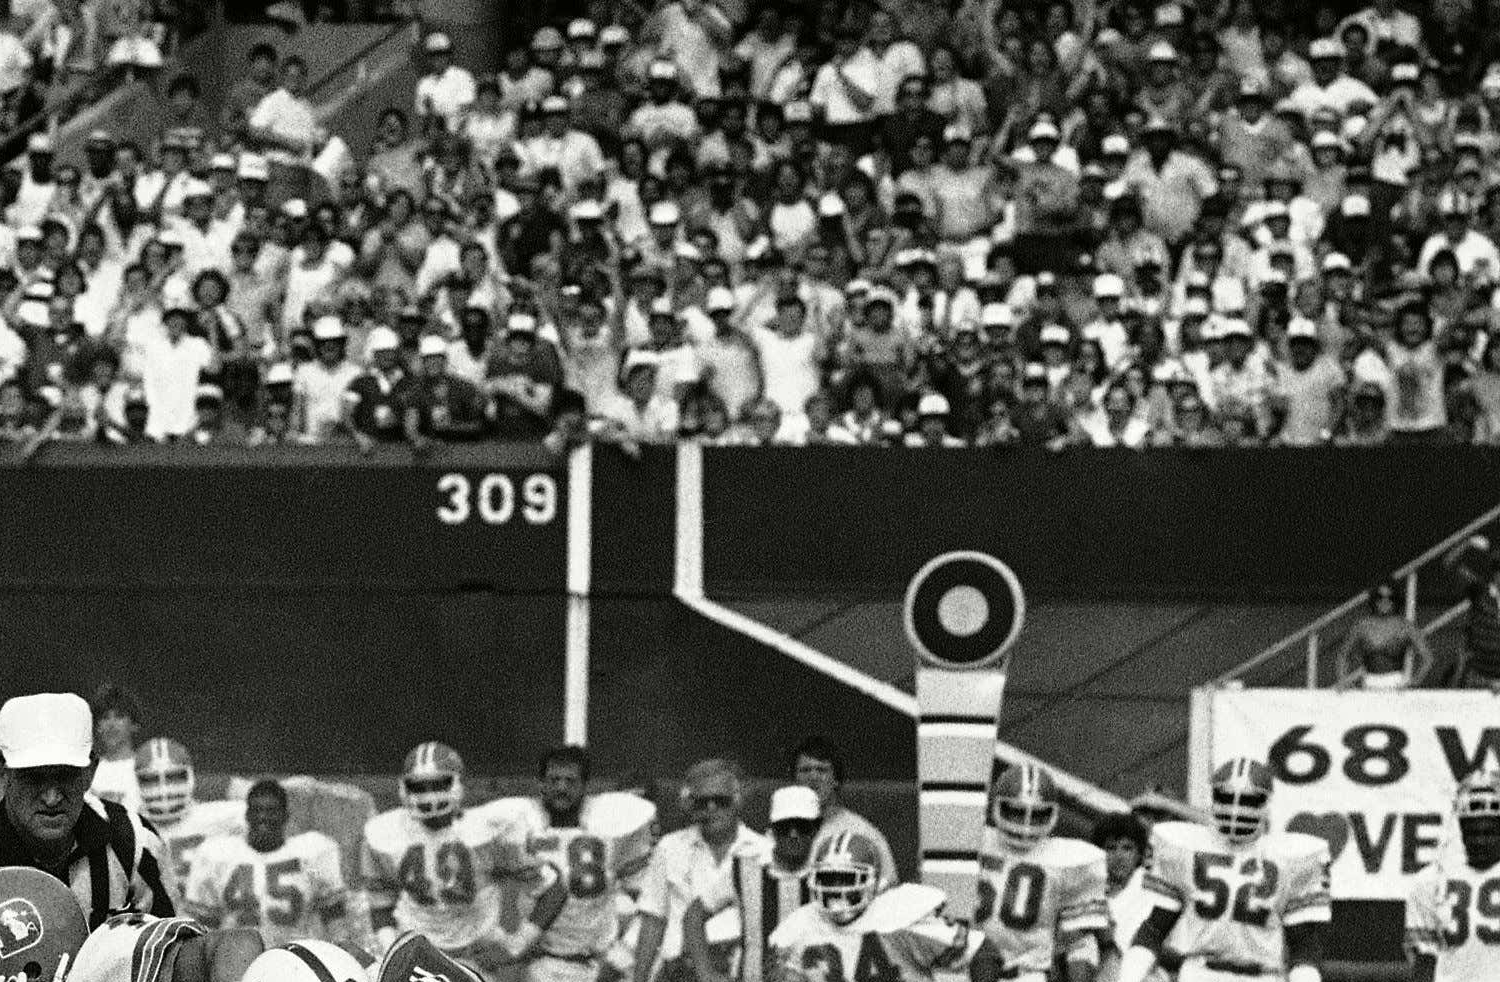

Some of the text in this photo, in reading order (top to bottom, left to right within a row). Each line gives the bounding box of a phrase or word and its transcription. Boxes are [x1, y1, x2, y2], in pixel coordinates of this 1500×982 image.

[437, 473, 556, 524] 309
[1268, 724, 1409, 787] 68
[222, 857, 302, 927] 45
[400, 841, 477, 904] 49
[1192, 851, 1279, 928] 52
[1443, 878, 1500, 949] 39
